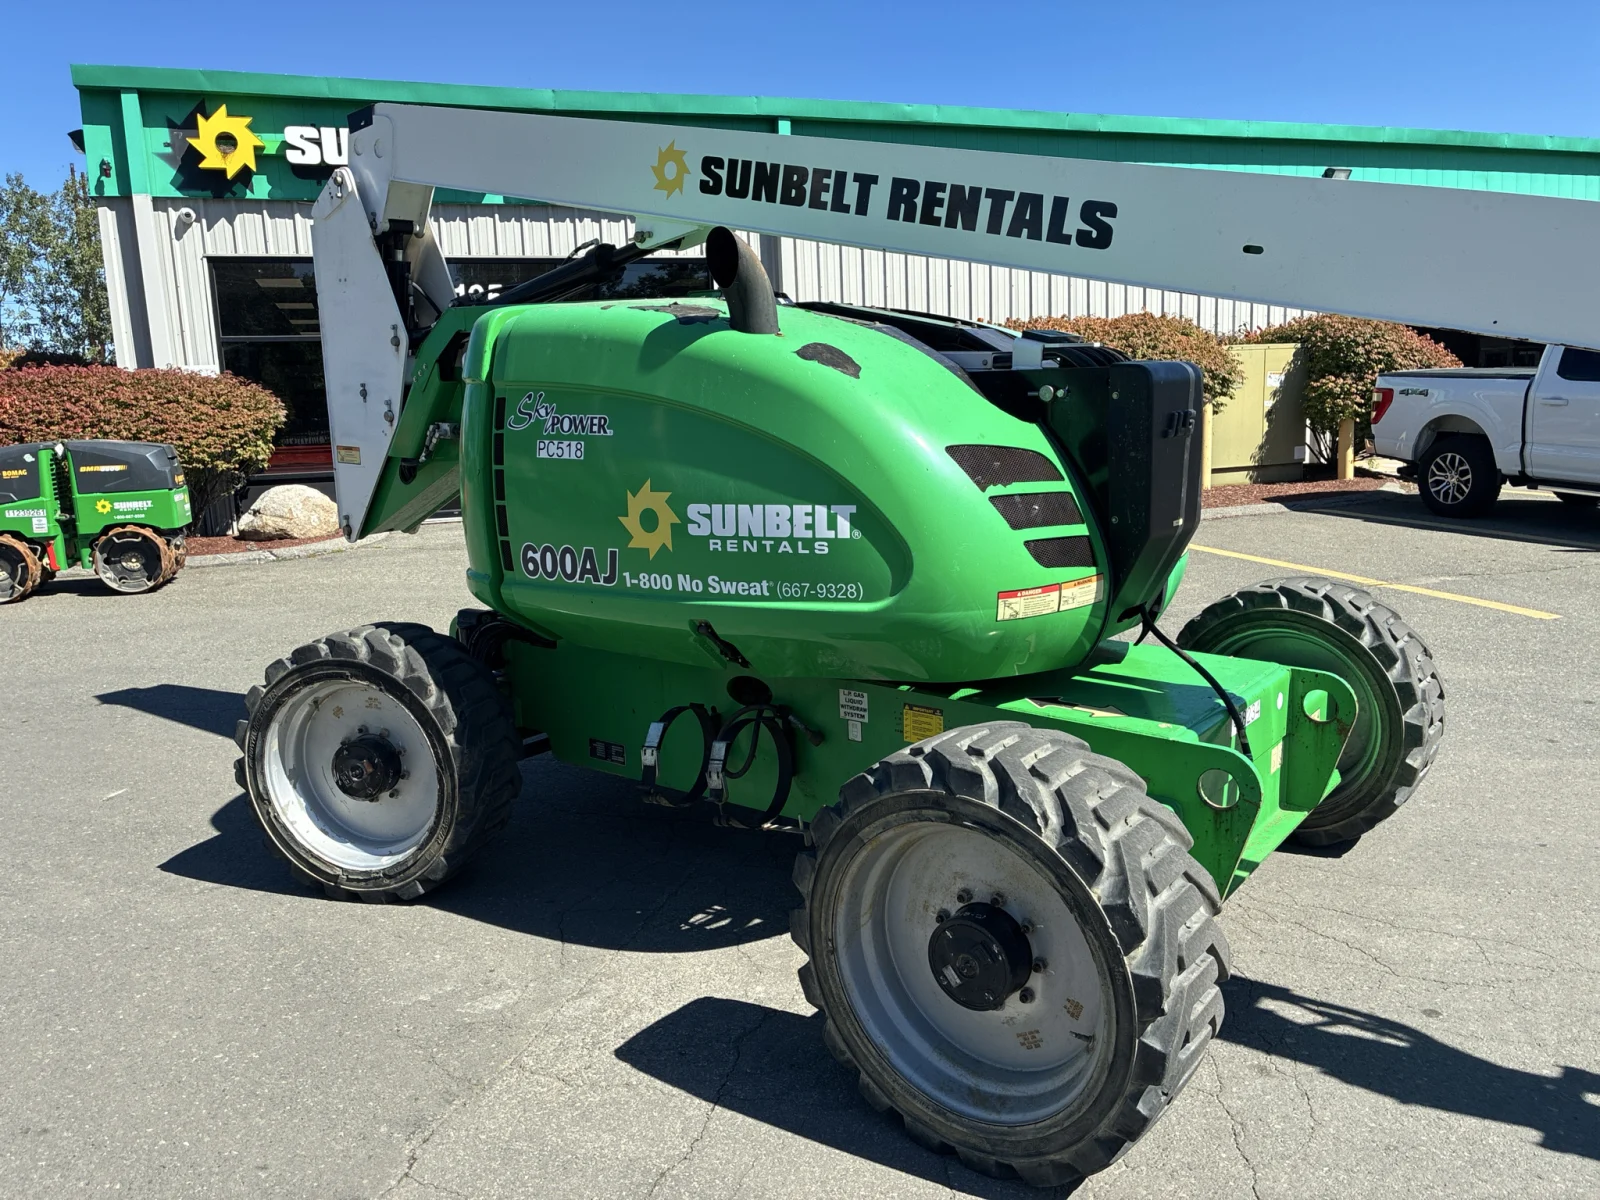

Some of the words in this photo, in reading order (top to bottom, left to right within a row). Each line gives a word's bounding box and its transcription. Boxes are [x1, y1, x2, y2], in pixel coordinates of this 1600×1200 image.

[699, 155, 879, 217] SUNBELT
[886, 176, 1119, 250] RENTALS
[507, 392, 556, 435] Sky
[548, 415, 611, 435] POWER
[538, 440, 583, 459] PC518
[2, 469, 27, 477] BOMAG
[113, 500, 152, 509] SUNBELT
[687, 503, 857, 539] SUNBELT
[709, 539, 829, 554] RENTALS
[521, 542, 618, 586] 600AJ
[623, 572, 672, 590] 1-800
[677, 573, 703, 593] No
[707, 575, 770, 596] Sweat
[776, 581, 864, 601] (667-9328)
[1022, 588, 1042, 596] DANGER
[840, 704, 867, 713] WITHDRAW
[844, 697, 863, 706] LIQUID
[843, 711, 866, 720] SYSTEM
